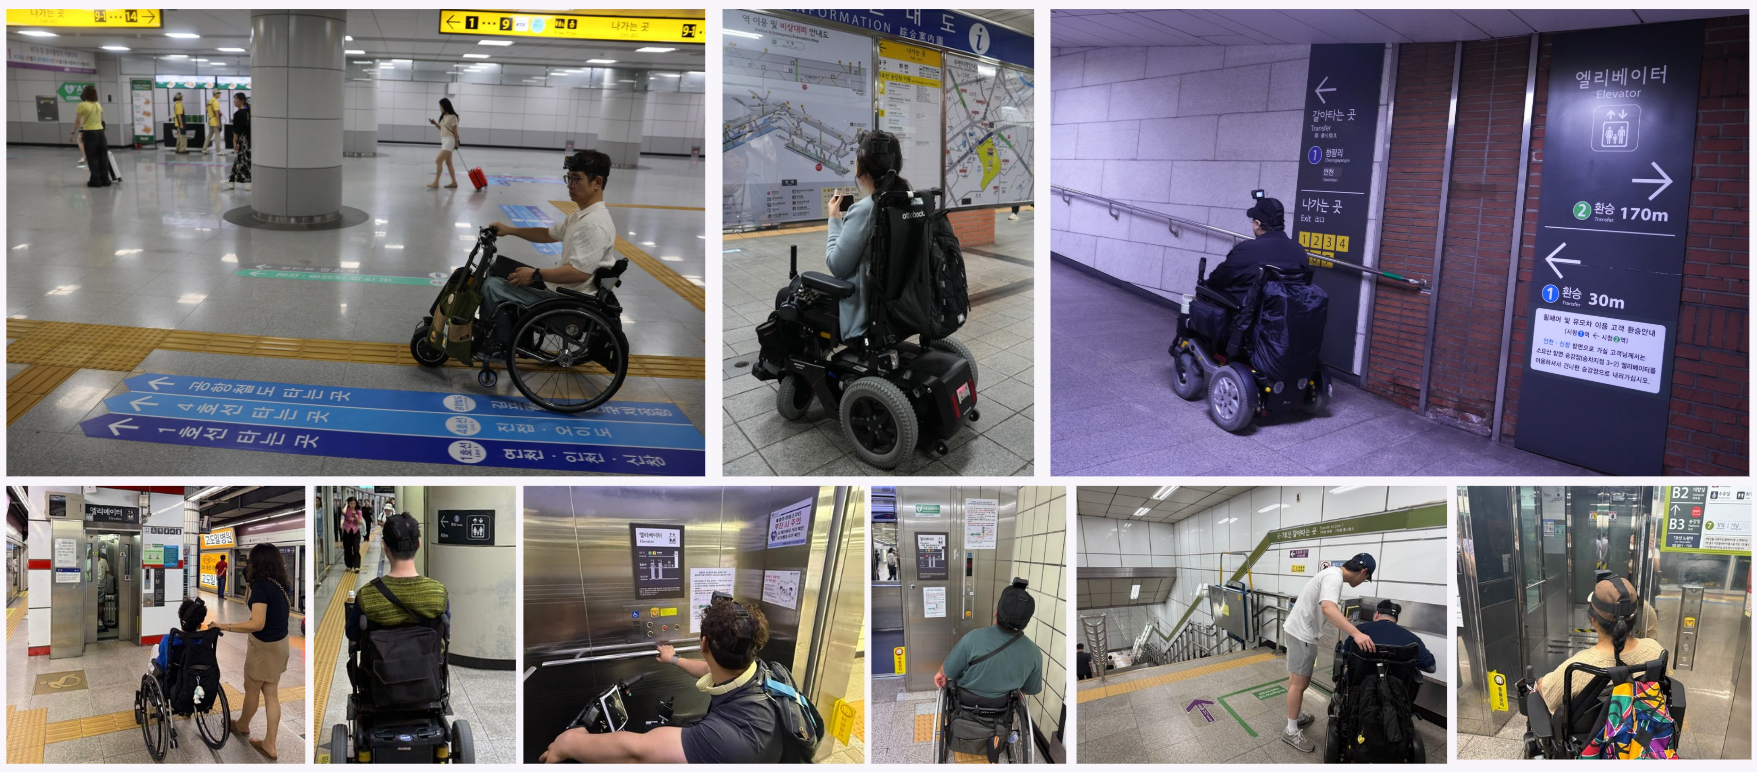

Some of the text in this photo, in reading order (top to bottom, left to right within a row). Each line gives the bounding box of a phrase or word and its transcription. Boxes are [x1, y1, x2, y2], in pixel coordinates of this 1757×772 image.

[126, 12, 137, 21] 14
[468, 18, 474, 29] 1
[502, 19, 510, 30] 9
[611, 21, 649, 33] 나가는 곳
[683, 25, 696, 37] 9-1
[742, 15, 829, 39] 역 이용 및 비상대피 안내도
[906, 48, 920, 56] 나가는
[1576, 65, 1667, 90] 엘리베이터
[1596, 89, 1641, 99] Elevator
[1312, 108, 1357, 122] 갈아타는 곳
[1326, 148, 1343, 158] 청량리
[1302, 198, 1342, 214] 나가는 곳
[1594, 202, 1616, 215] 환승
[1620, 206, 1669, 222] 170m
[1300, 214, 1311, 222] Exit
[1303, 234, 1345, 249] 1 2 3 4
[1562, 286, 1582, 300] 환승
[1588, 292, 1625, 310] 30m
[1543, 314, 1562, 323] 휠체어
[1573, 318, 1592, 328] 유모차
[1594, 321, 1608, 330] 이용
[1611, 324, 1624, 333] 고객
[1627, 325, 1656, 337] 환승안내
[1572, 343, 1594, 352] 방면으로
[1610, 349, 1646, 362] 고객님께서는
[1535, 358, 1562, 368] 이용하셔서
[1563, 362, 1580, 371] 건너편
[1582, 366, 1610, 377] 승강장으로
[1536, 348, 1551, 356] 소요산
[1606, 359, 1620, 367] 3-2)
[1621, 362, 1656, 374] 엘리베이터를
[188, 380, 352, 402] 공항철도 타는 곳
[176, 402, 330, 423] 4호선 타는 곳
[455, 418, 468, 435] 4호선
[555, 425, 612, 438] 오이도
[158, 425, 319, 448] 1호선 타는 곳
[459, 442, 473, 461] 1호선
[503, 448, 666, 467] 연천 인천 신창
[1672, 487, 1689, 499] B2
[90, 506, 123, 516] 엘리베이터
[791, 517, 801, 526] 주의
[1669, 518, 1685, 530] B3
[205, 532, 232, 545] 고도일병원
[1292, 529, 1310, 538] 갈아타는
[1312, 527, 1317, 535] 곳
